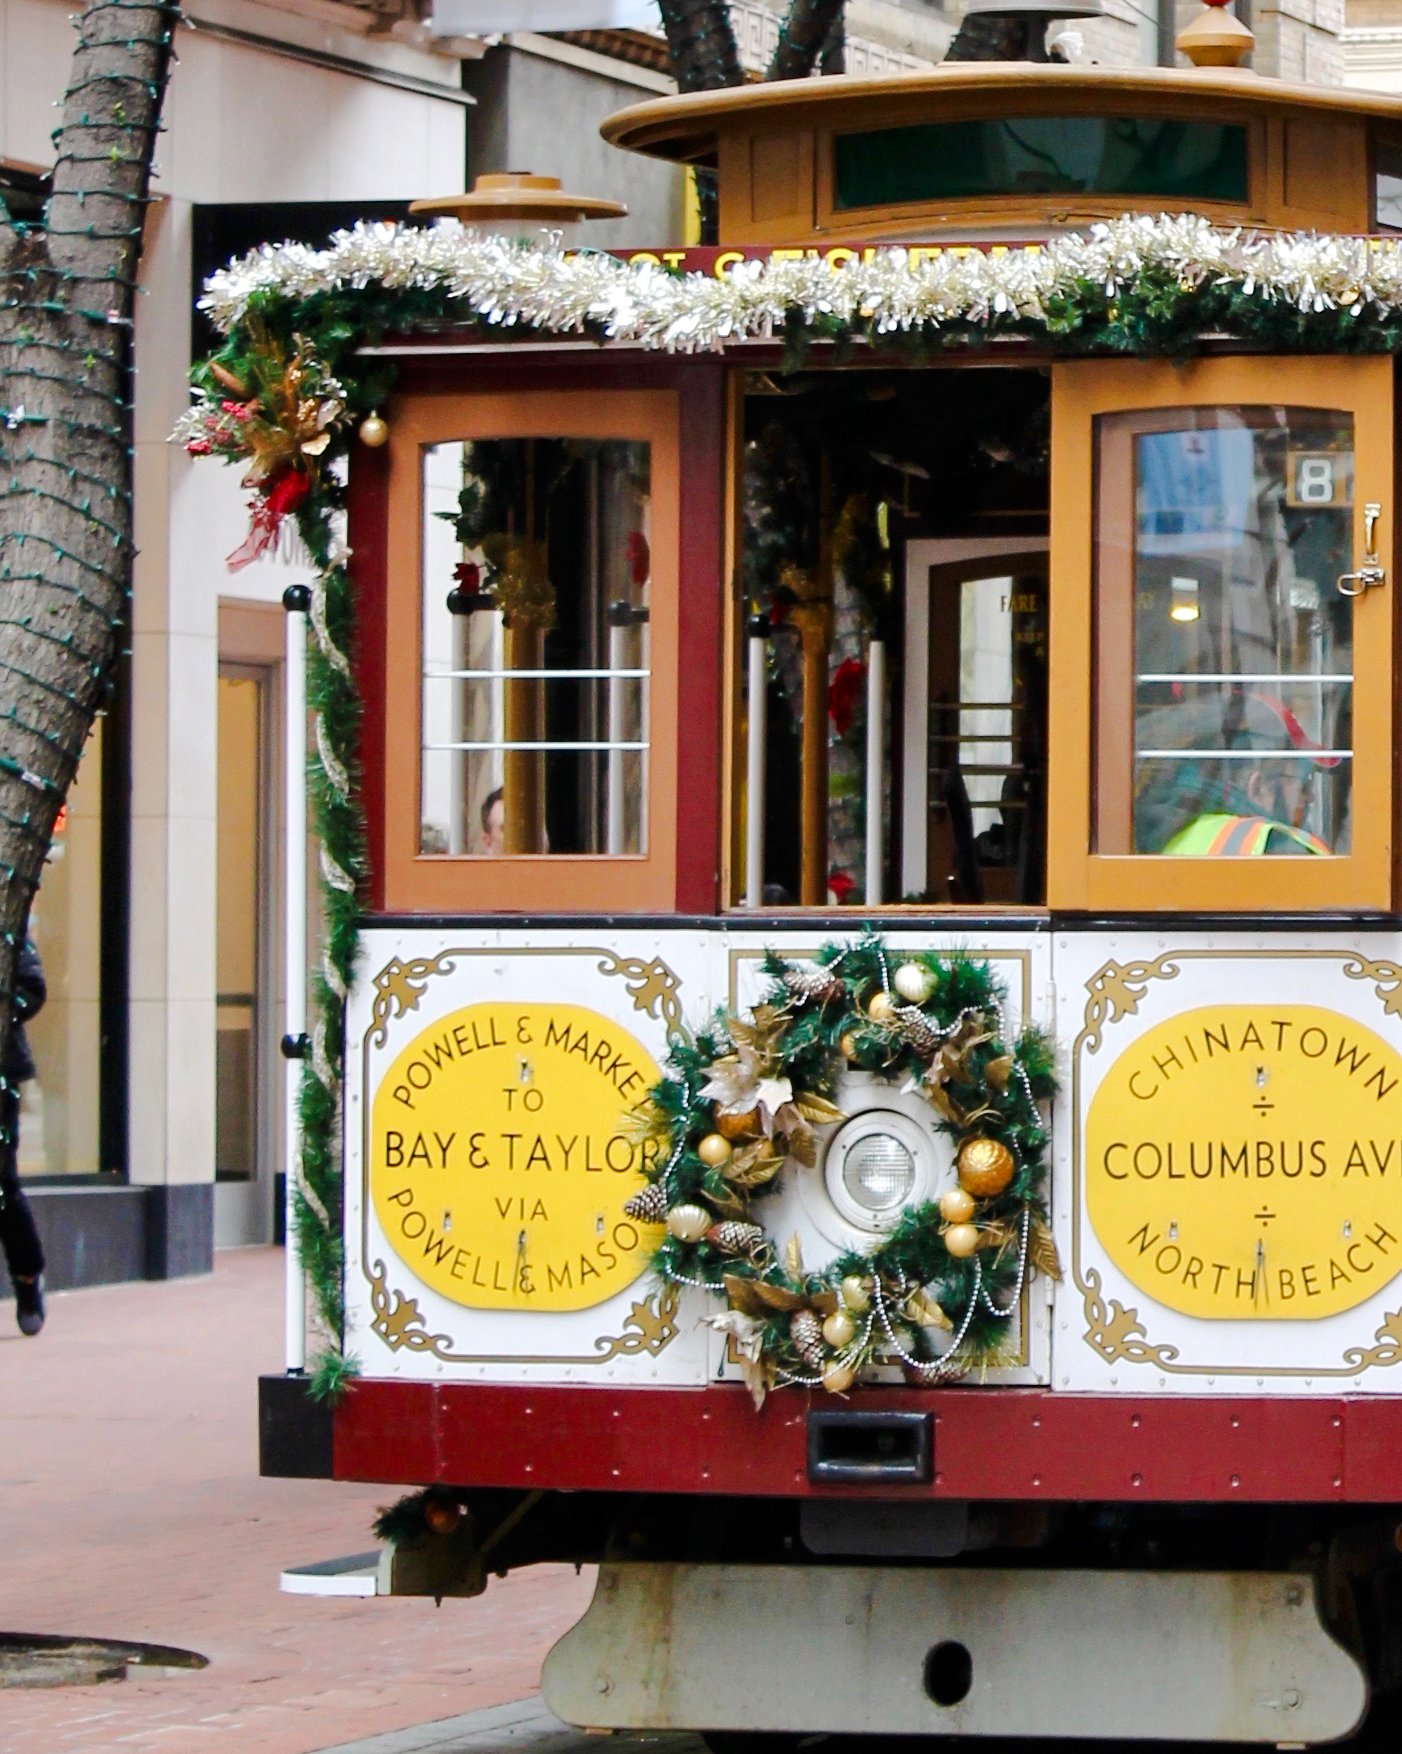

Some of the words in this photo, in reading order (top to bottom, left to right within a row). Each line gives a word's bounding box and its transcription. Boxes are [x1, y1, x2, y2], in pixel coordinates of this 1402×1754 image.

[1299, 458, 1334, 504] 8
[393, 1017, 506, 1111] POWELL
[516, 1016, 532, 1044] &
[1128, 1020, 1399, 1102] CHINATOWN
[502, 1088, 544, 1112] TO
[386, 1131, 456, 1169] BAY
[468, 1132, 489, 1169] &
[501, 1134, 660, 1173] TAYLOR
[1104, 1140, 1327, 1180] COLUMBUS
[495, 1197, 549, 1221] VIA
[387, 1188, 506, 1293] POWELL
[519, 1264, 535, 1294] &
[548, 1222, 639, 1293] MASO
[1127, 1222, 1258, 1300] NORTH
[1278, 1222, 1398, 1300] BEACH
